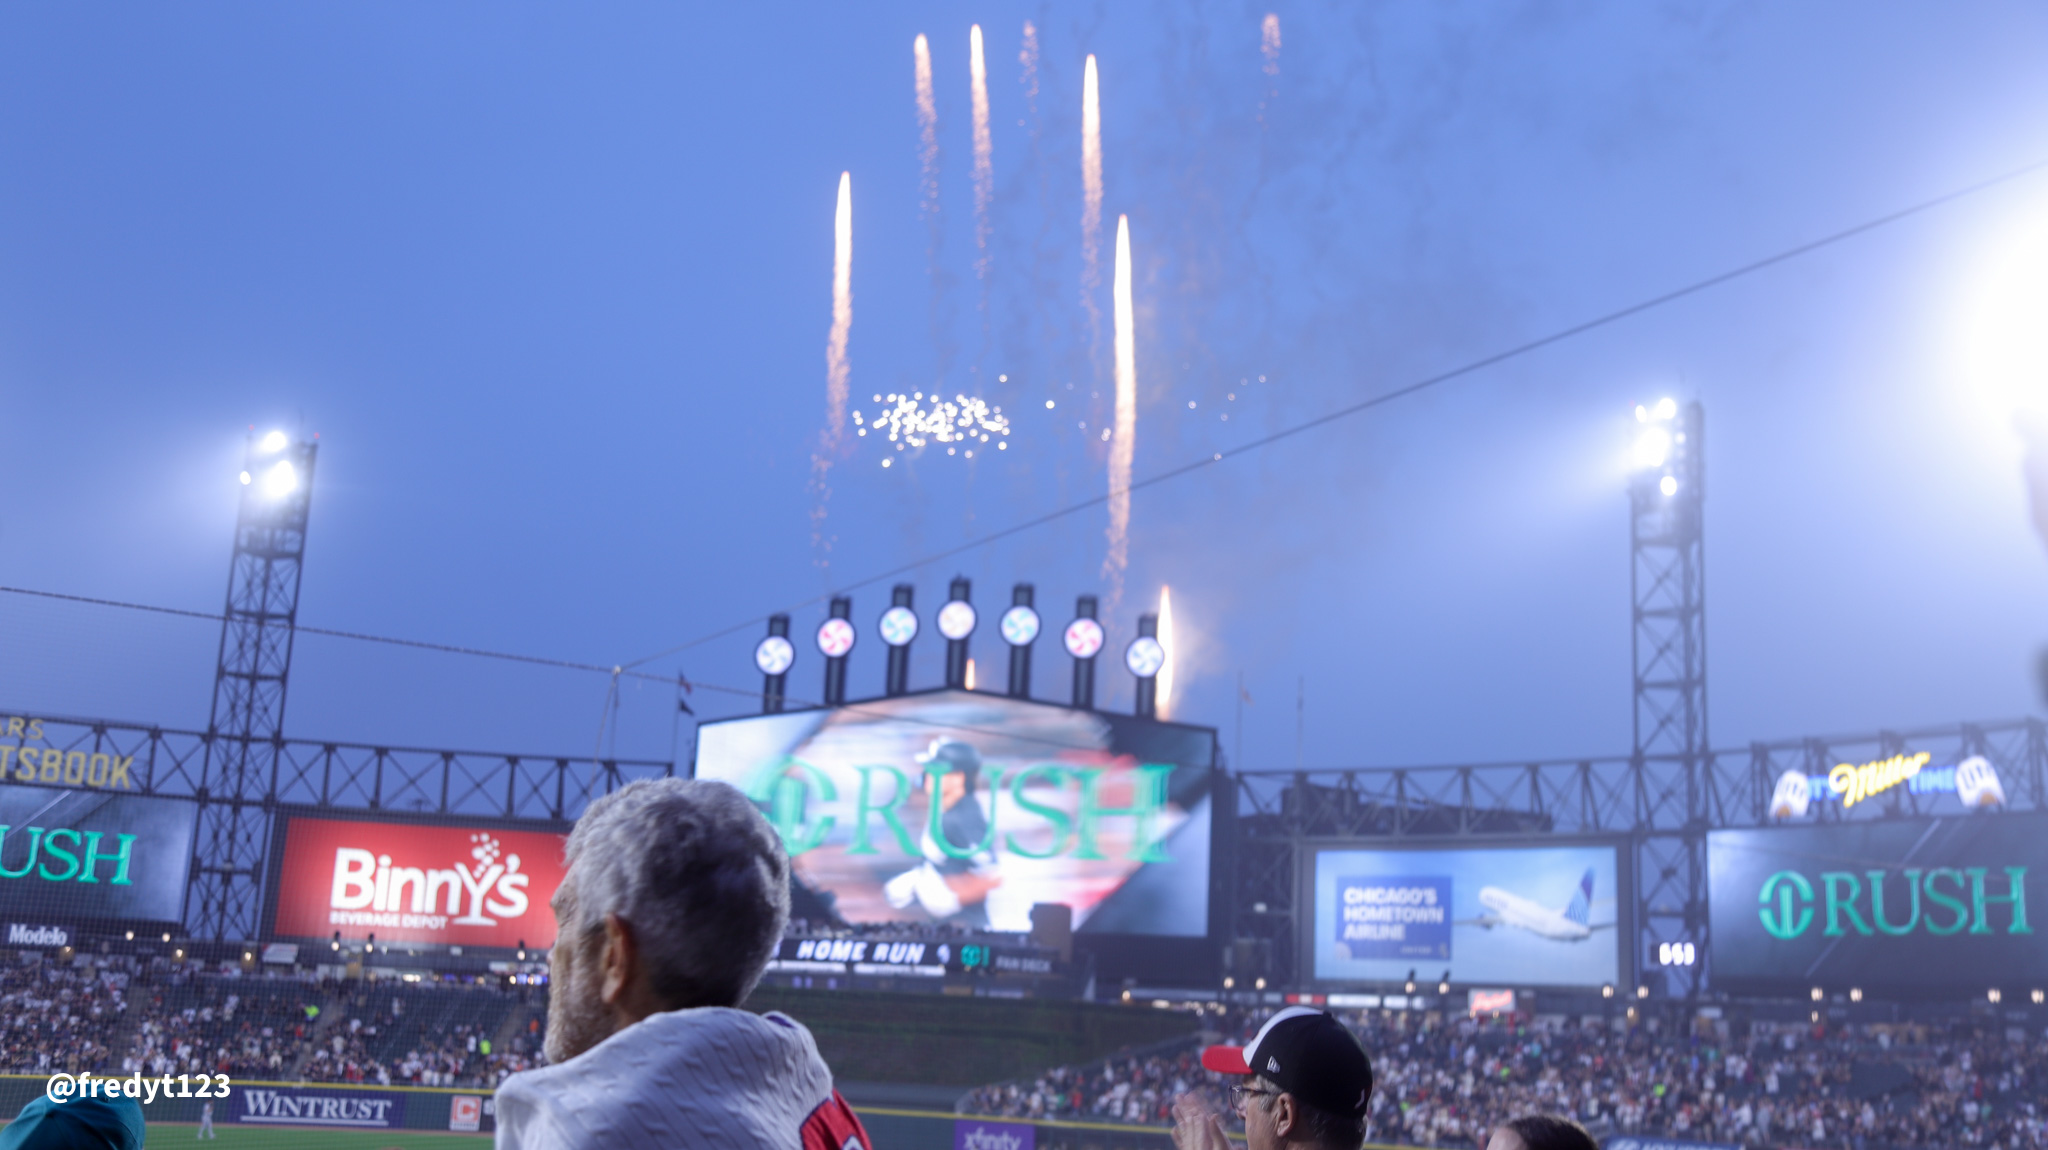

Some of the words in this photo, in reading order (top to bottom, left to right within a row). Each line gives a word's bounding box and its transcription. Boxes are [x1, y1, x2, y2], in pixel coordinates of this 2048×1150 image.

[0, 717, 44, 740] RS
[1829, 752, 1931, 808] Miller
[1343, 886, 1438, 905] CHICAGO'S
[1821, 866, 2034, 937] RUSH
[329, 911, 398, 928] BEVERAGE
[401, 914, 448, 930] DEPOT
[1343, 906, 1444, 924] HOMETOWN
[9, 923, 68, 945] Modelo
[1343, 923, 1406, 941] AIRLINE
[796, 939, 868, 962] HOME
[871, 943, 925, 964] RUN
